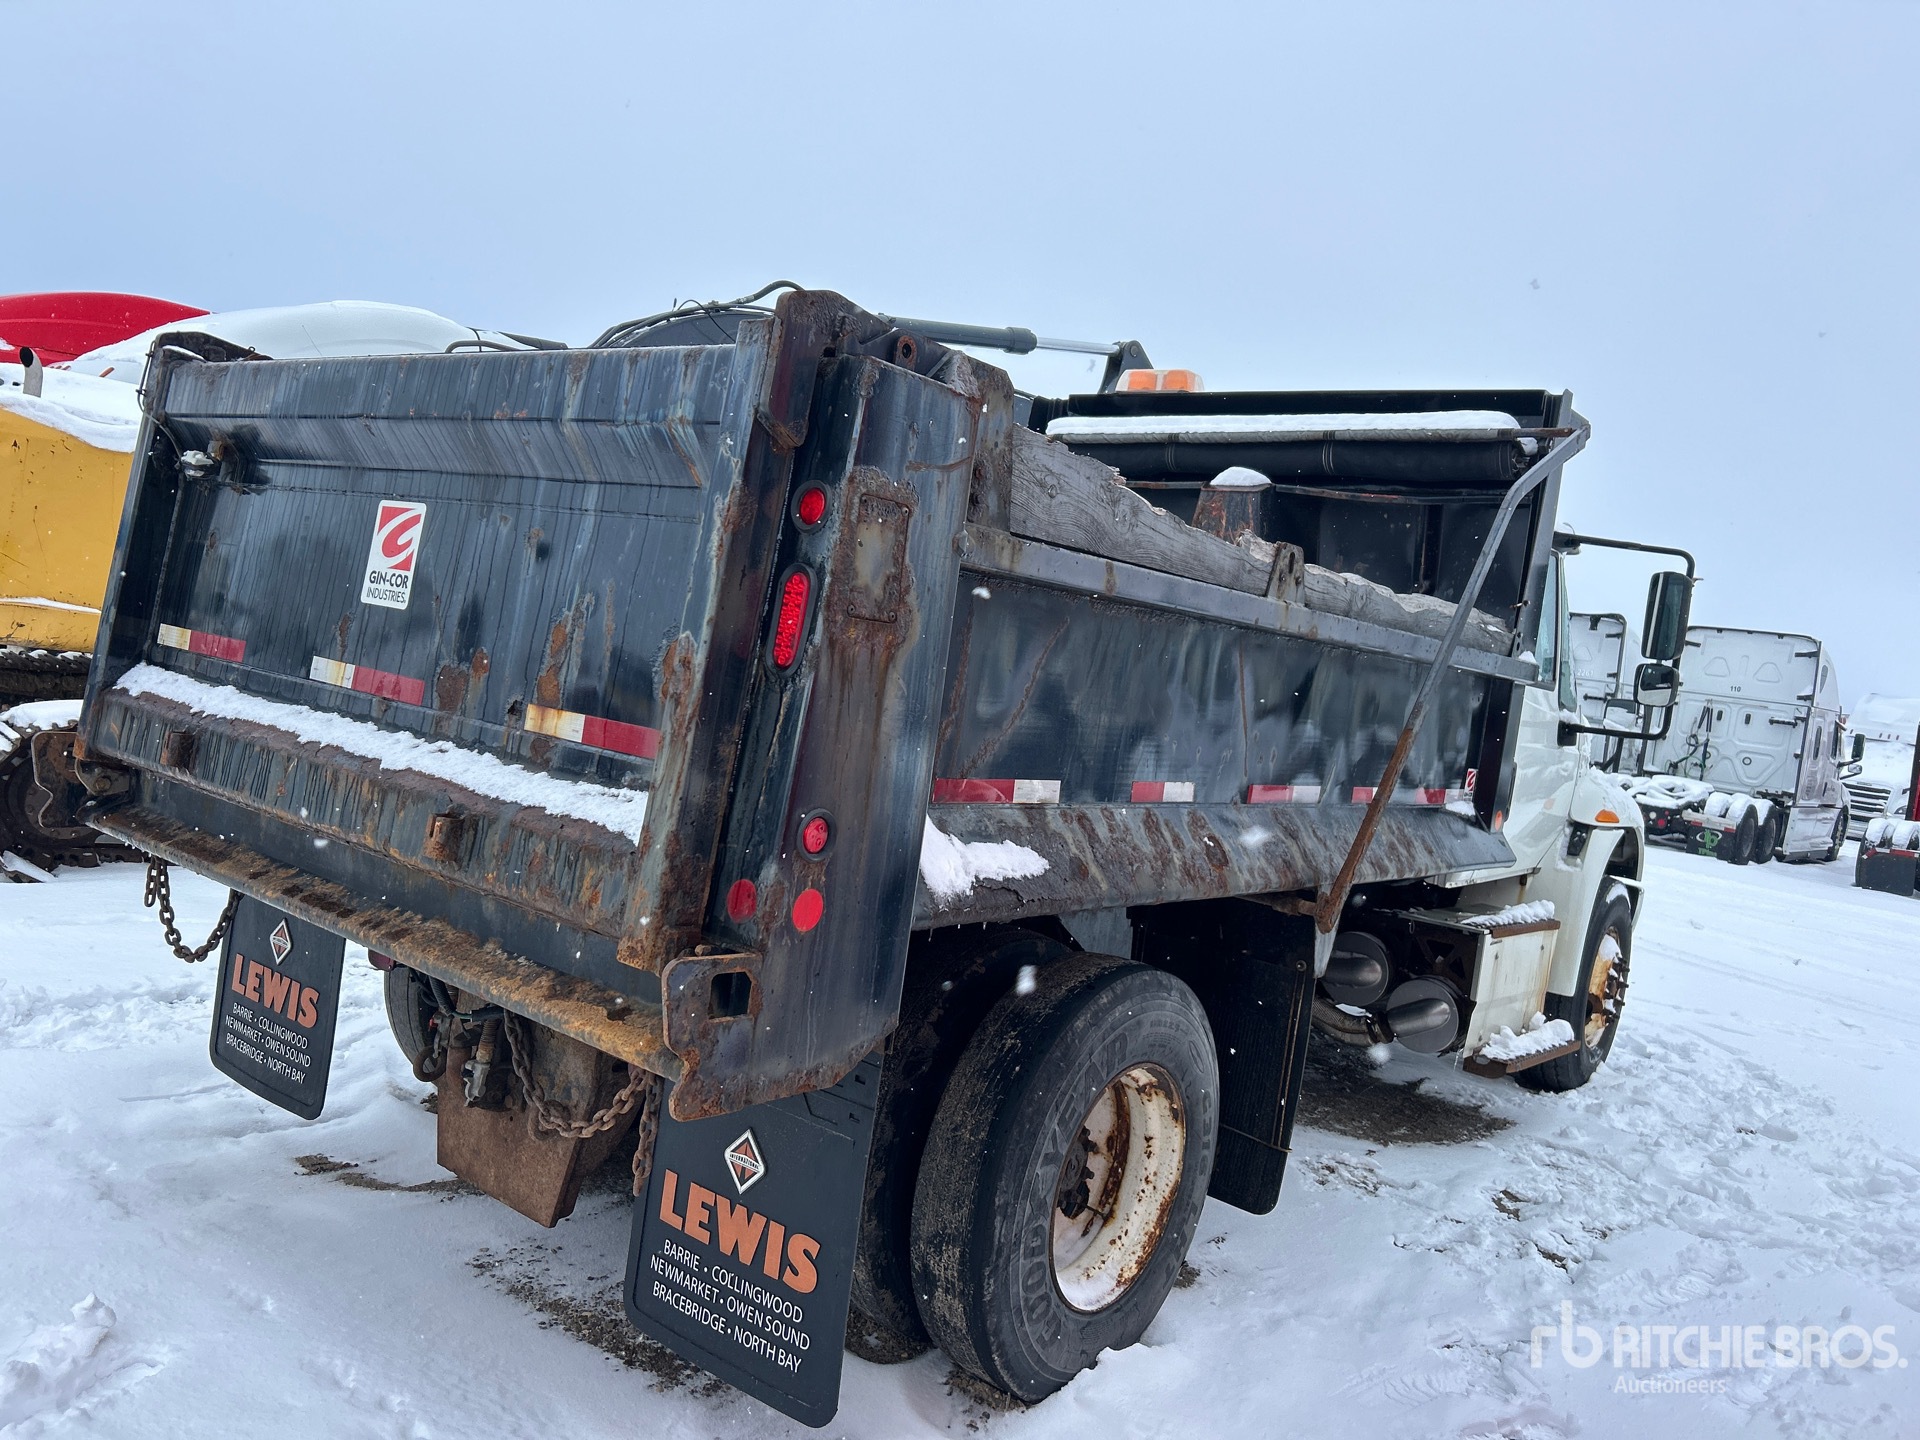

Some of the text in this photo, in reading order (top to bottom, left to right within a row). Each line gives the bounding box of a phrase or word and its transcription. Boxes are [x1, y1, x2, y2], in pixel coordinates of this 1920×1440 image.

[369, 570, 409, 588] GIN-COR
[1730, 685, 1742, 693] 110
[231, 953, 320, 1029] LEWIS
[225, 1015, 311, 1067] NEWMARKET OWEN SOUND
[233, 1002, 308, 1049] BARRIE COLLINGWOOD
[226, 1033, 306, 1084] BRACEBRIDGE NORTH BAY
[659, 1168, 821, 1294] LEWIS
[650, 1254, 811, 1350] NEWMARKET OWEN SOUND
[663, 1239, 803, 1323] BARRIE COLLINGWOOD
[652, 1281, 802, 1373] BRACEBRIDGE NORTH BAY
